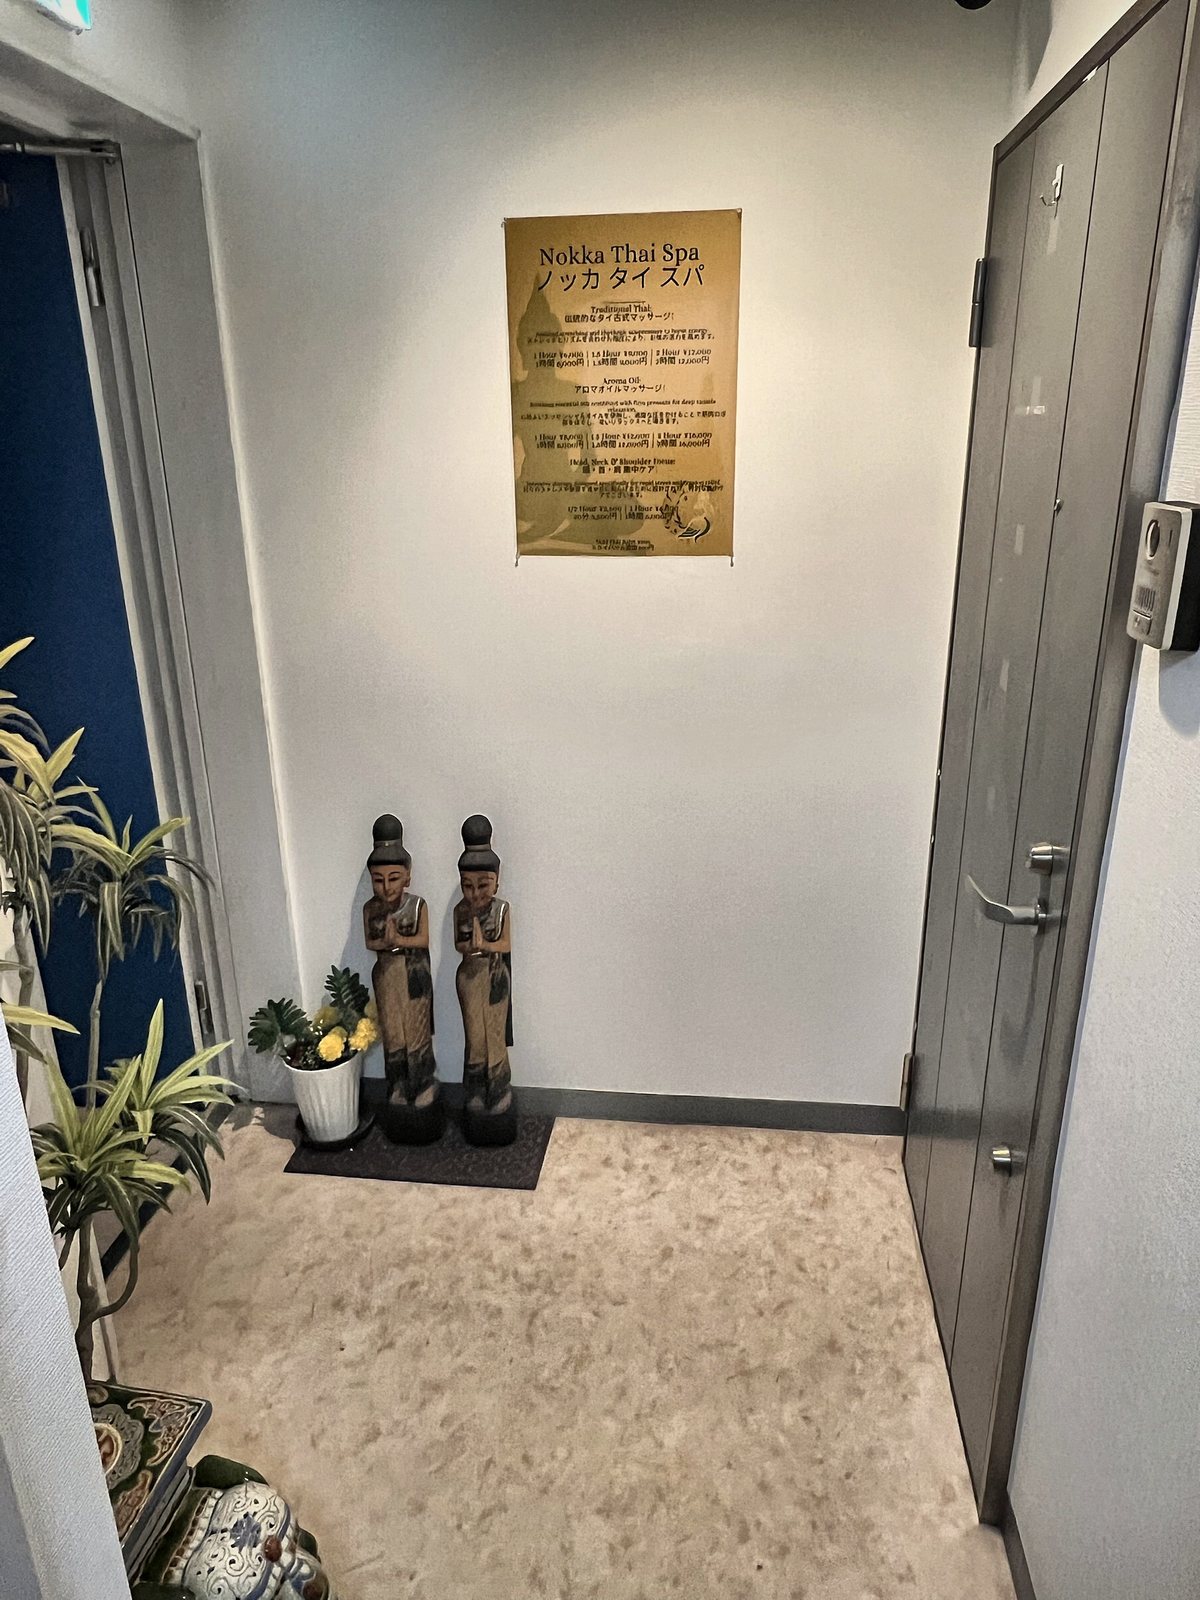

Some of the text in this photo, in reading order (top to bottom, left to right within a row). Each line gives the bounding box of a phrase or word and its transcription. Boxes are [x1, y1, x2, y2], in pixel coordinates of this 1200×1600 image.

[540, 243, 700, 266] Nokka Thai Spa
[537, 264, 705, 291] ノッカ タイ スパ
[662, 348, 680, 356] Hour
[603, 377, 627, 385] Aroma
